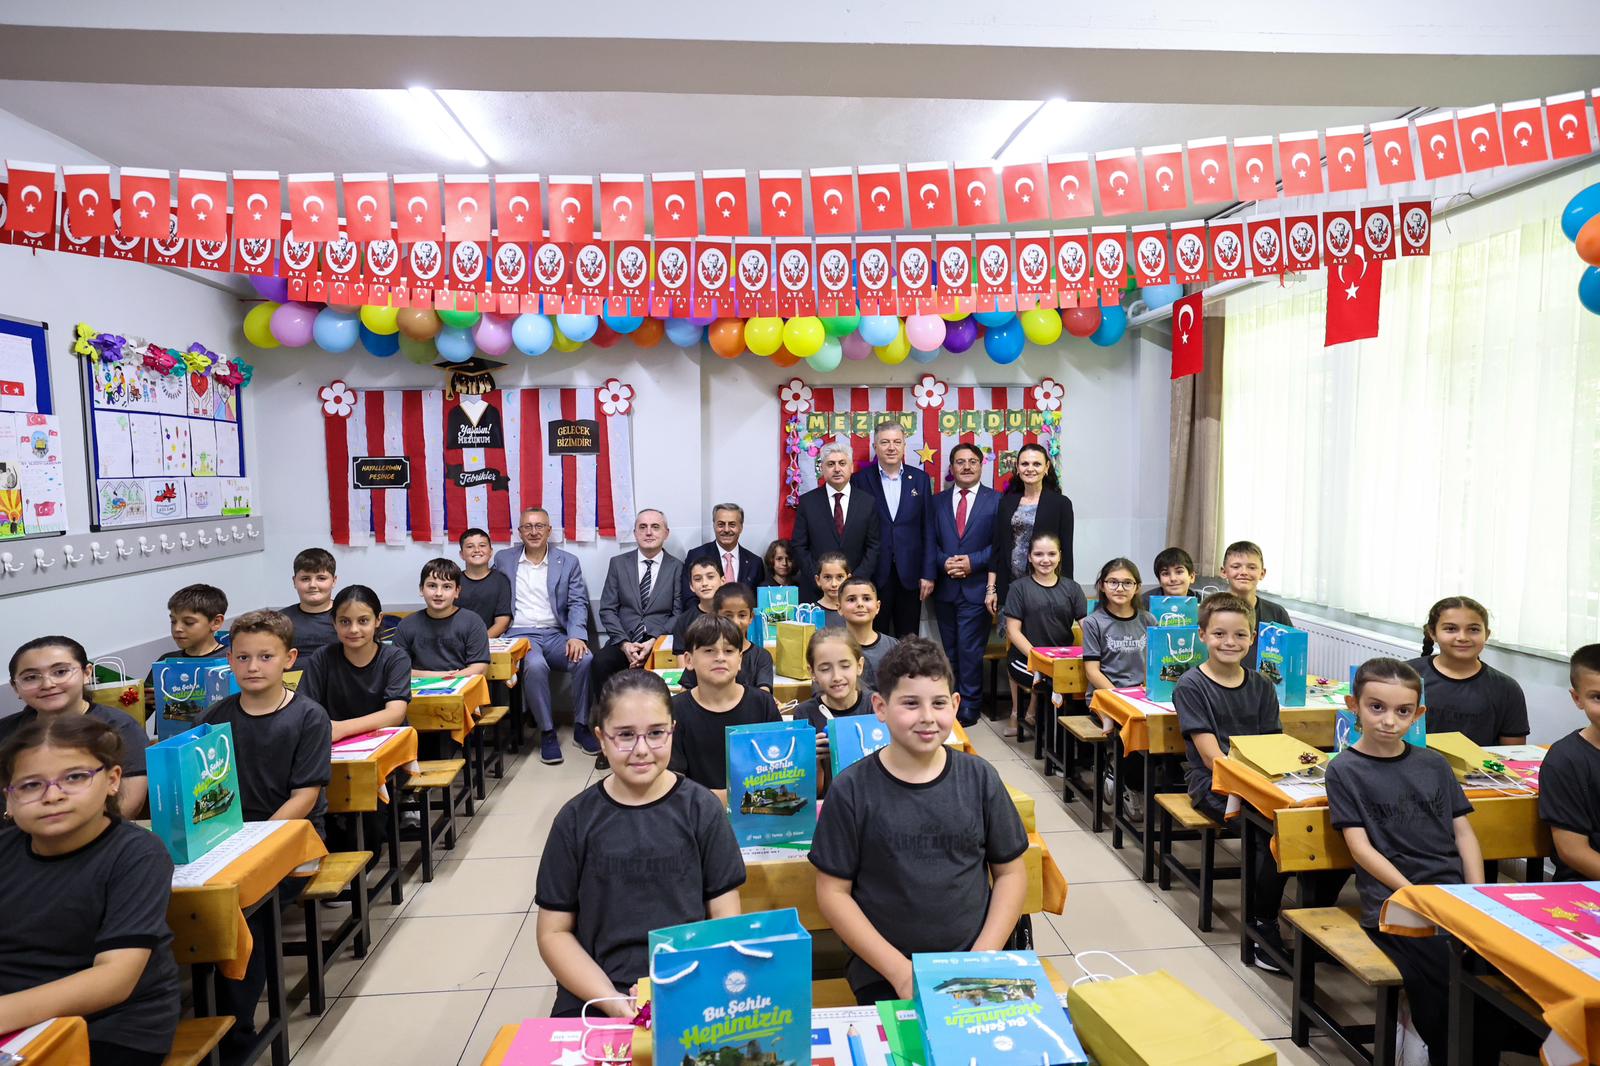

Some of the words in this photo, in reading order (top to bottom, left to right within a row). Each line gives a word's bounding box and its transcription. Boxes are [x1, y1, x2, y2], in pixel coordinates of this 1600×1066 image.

[22, 238, 43, 247] ATA
[68, 245, 87, 253] ATA
[113, 250, 133, 259] ATA
[1372, 252, 1388, 260] ATA
[200, 261, 219, 269] ATA
[244, 265, 263, 273] ATA
[942, 413, 1043, 428] OLDUM
[557, 425, 591, 436] GELECEK
[457, 435, 491, 444] MEZUNUM
[459, 470, 496, 486] Tebrikler
[703, 1006, 726, 1022] Bu
[727, 994, 772, 1018] Şehir
[678, 1005, 793, 1049] Hepimizin
